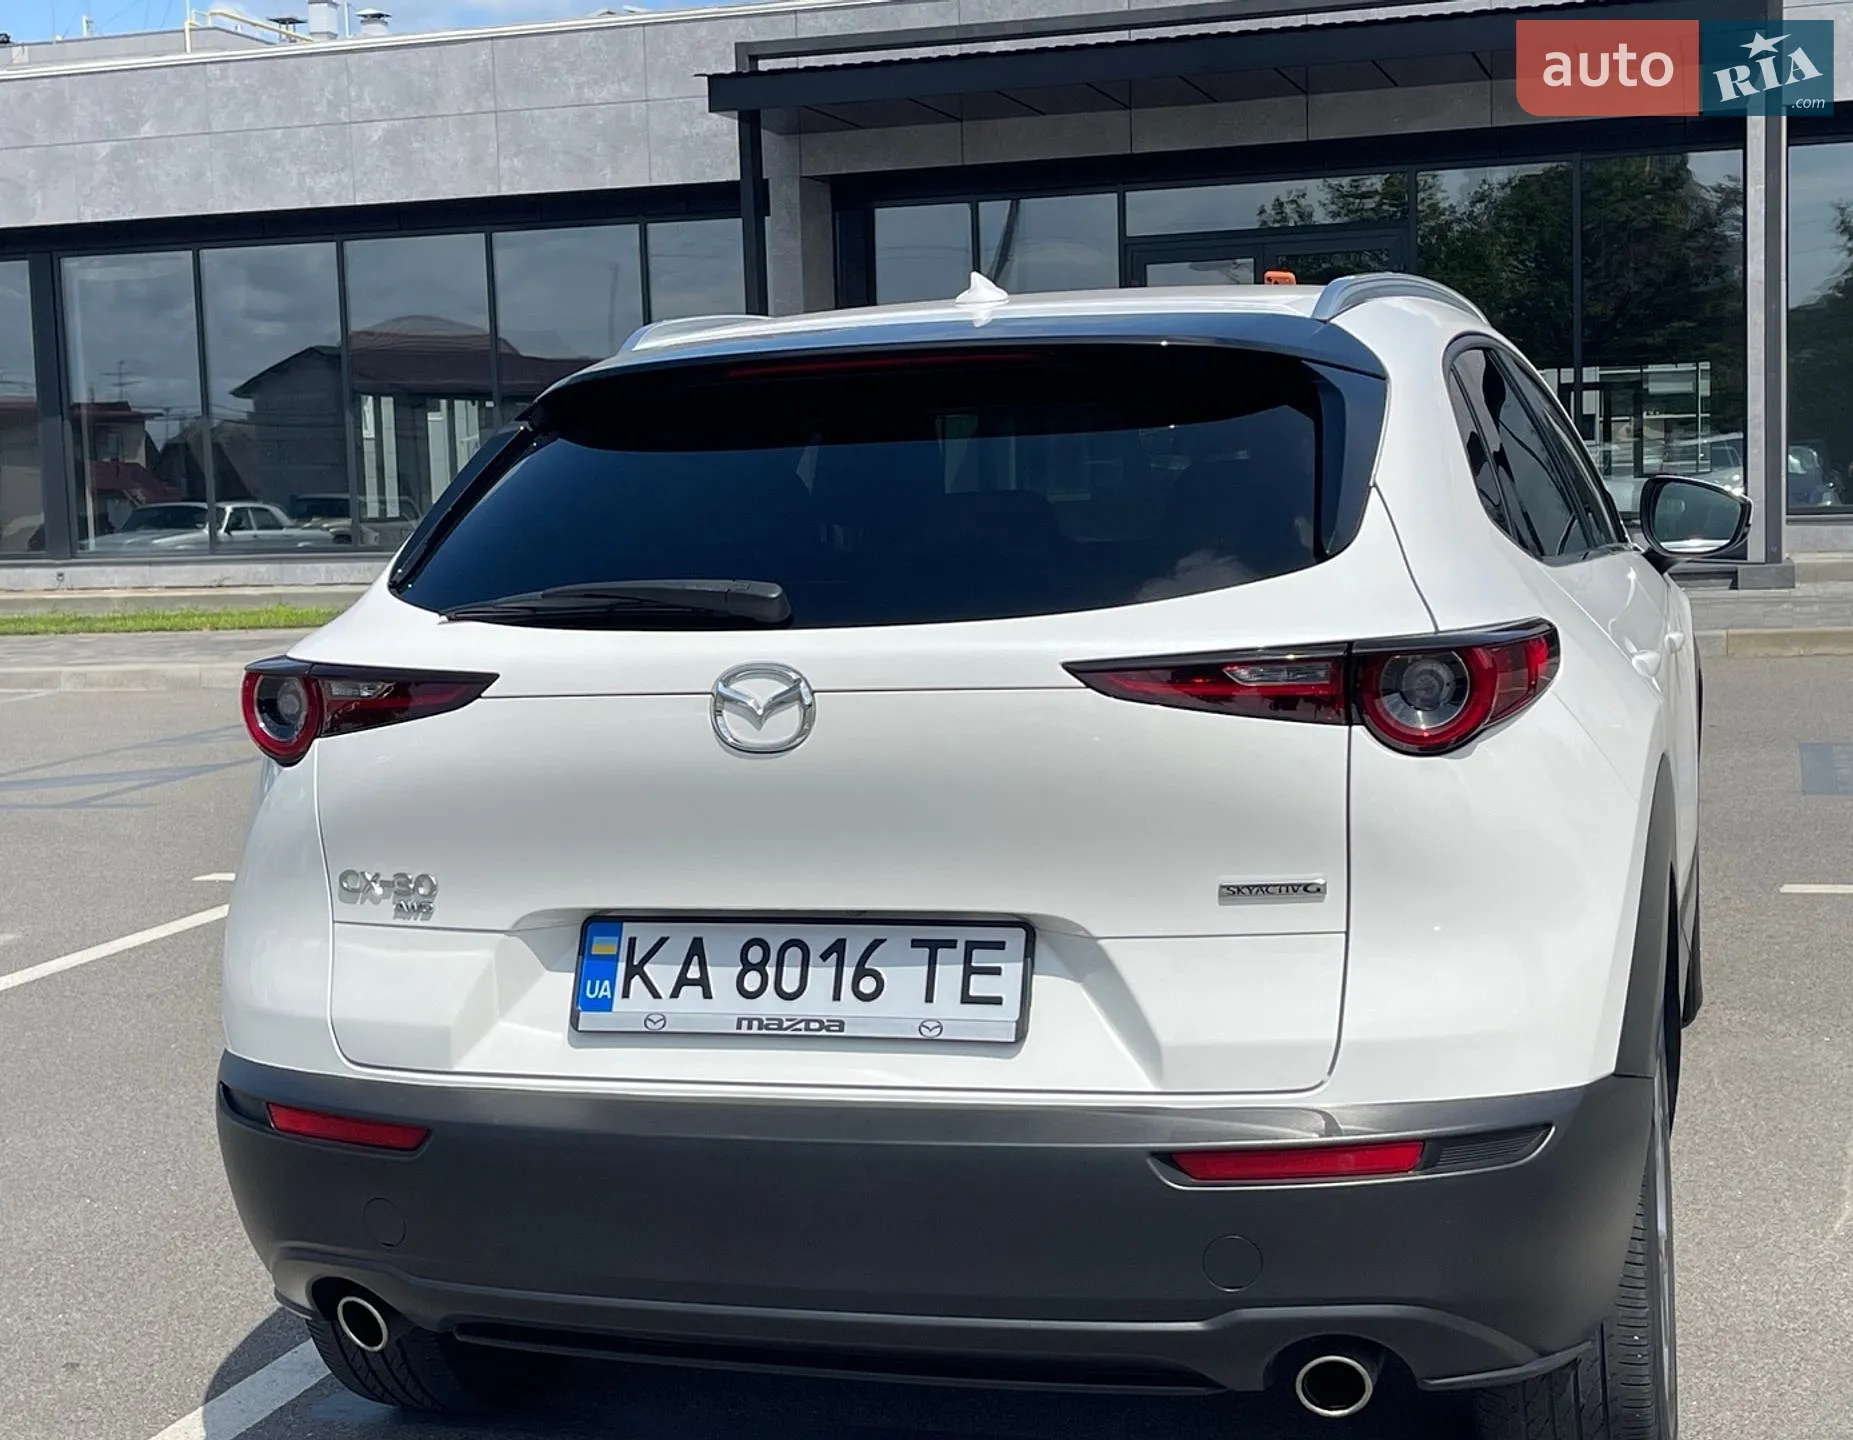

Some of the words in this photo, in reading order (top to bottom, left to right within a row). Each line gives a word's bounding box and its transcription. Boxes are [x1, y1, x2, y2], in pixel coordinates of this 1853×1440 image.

[338, 869, 439, 898] CX-30
[621, 936, 713, 1000] KA
[735, 937, 888, 1003] 8016
[910, 938, 1006, 1006] TE
[586, 979, 612, 999] UA
